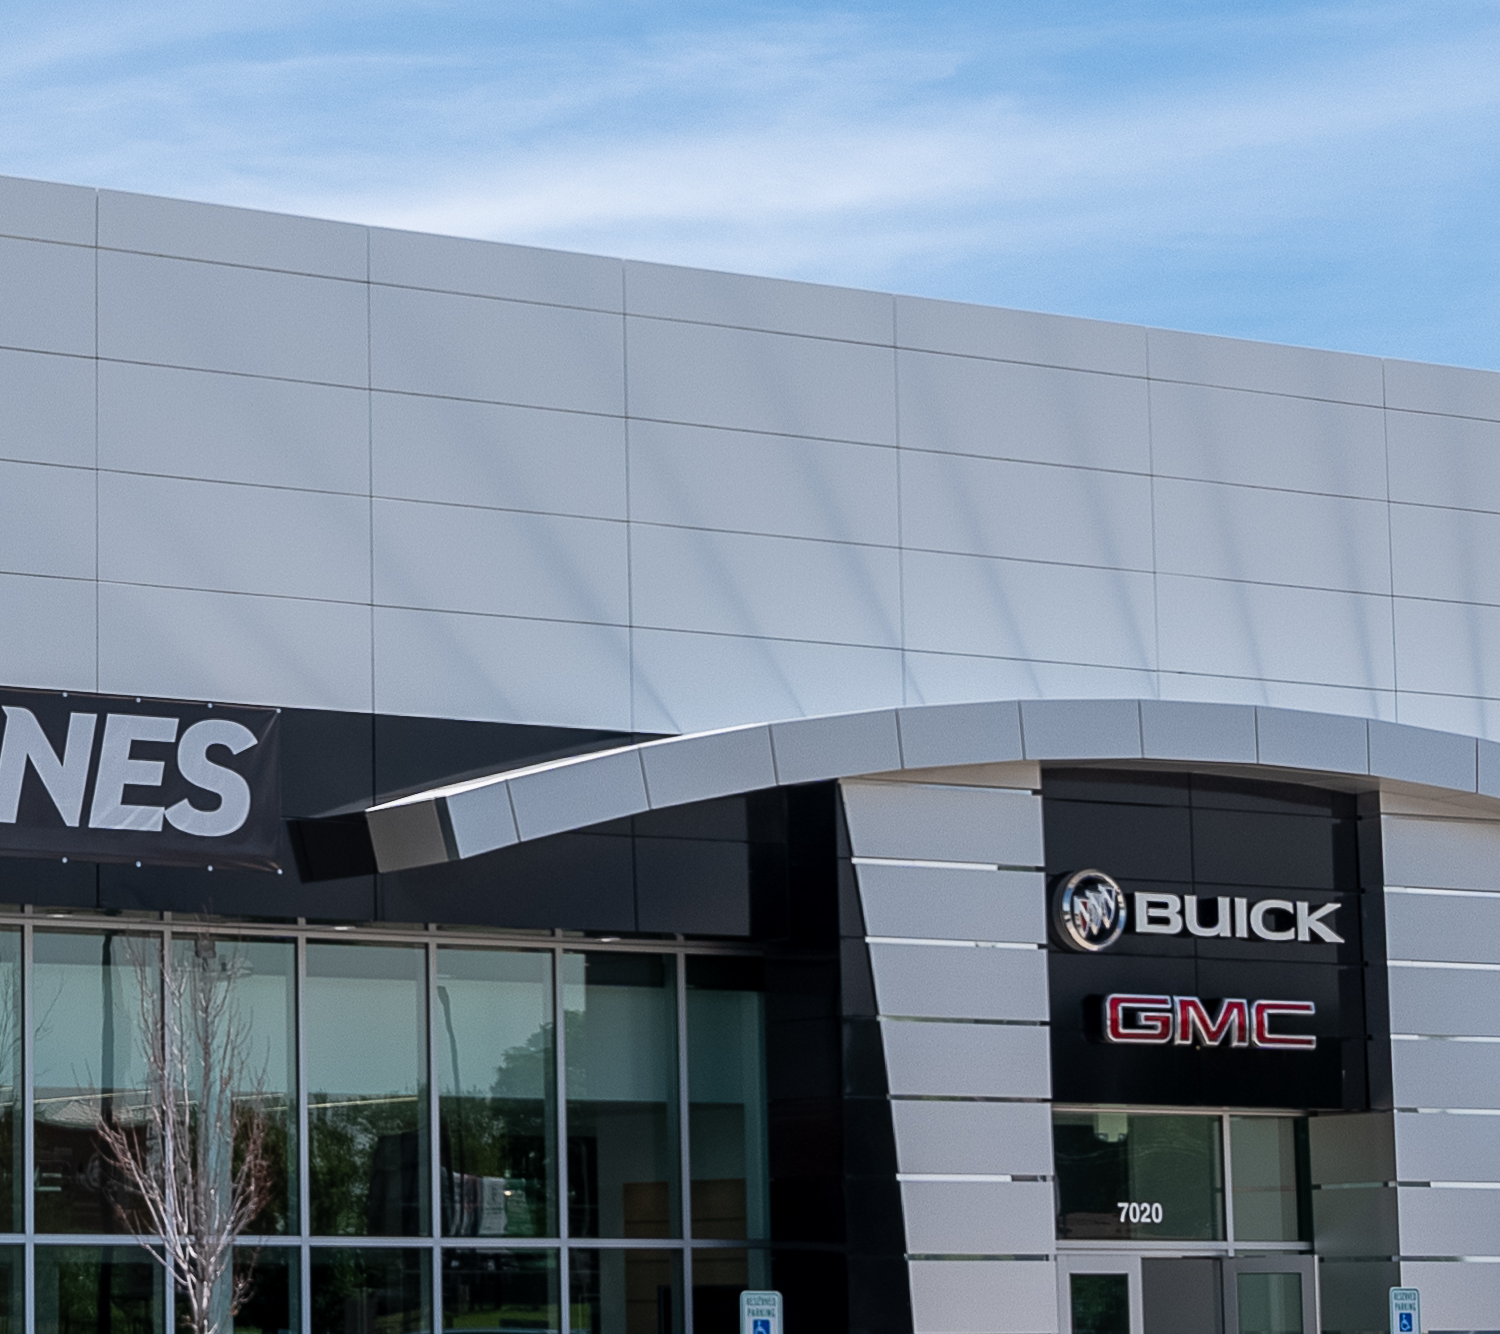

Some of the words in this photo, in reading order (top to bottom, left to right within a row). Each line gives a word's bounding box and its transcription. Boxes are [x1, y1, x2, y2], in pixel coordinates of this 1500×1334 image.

[1135, 891, 1345, 943] BUICK
[1105, 993, 1316, 1049] GMC
[1117, 1202, 1163, 1223] 7020
[747, 1308, 775, 1317] PARKING
